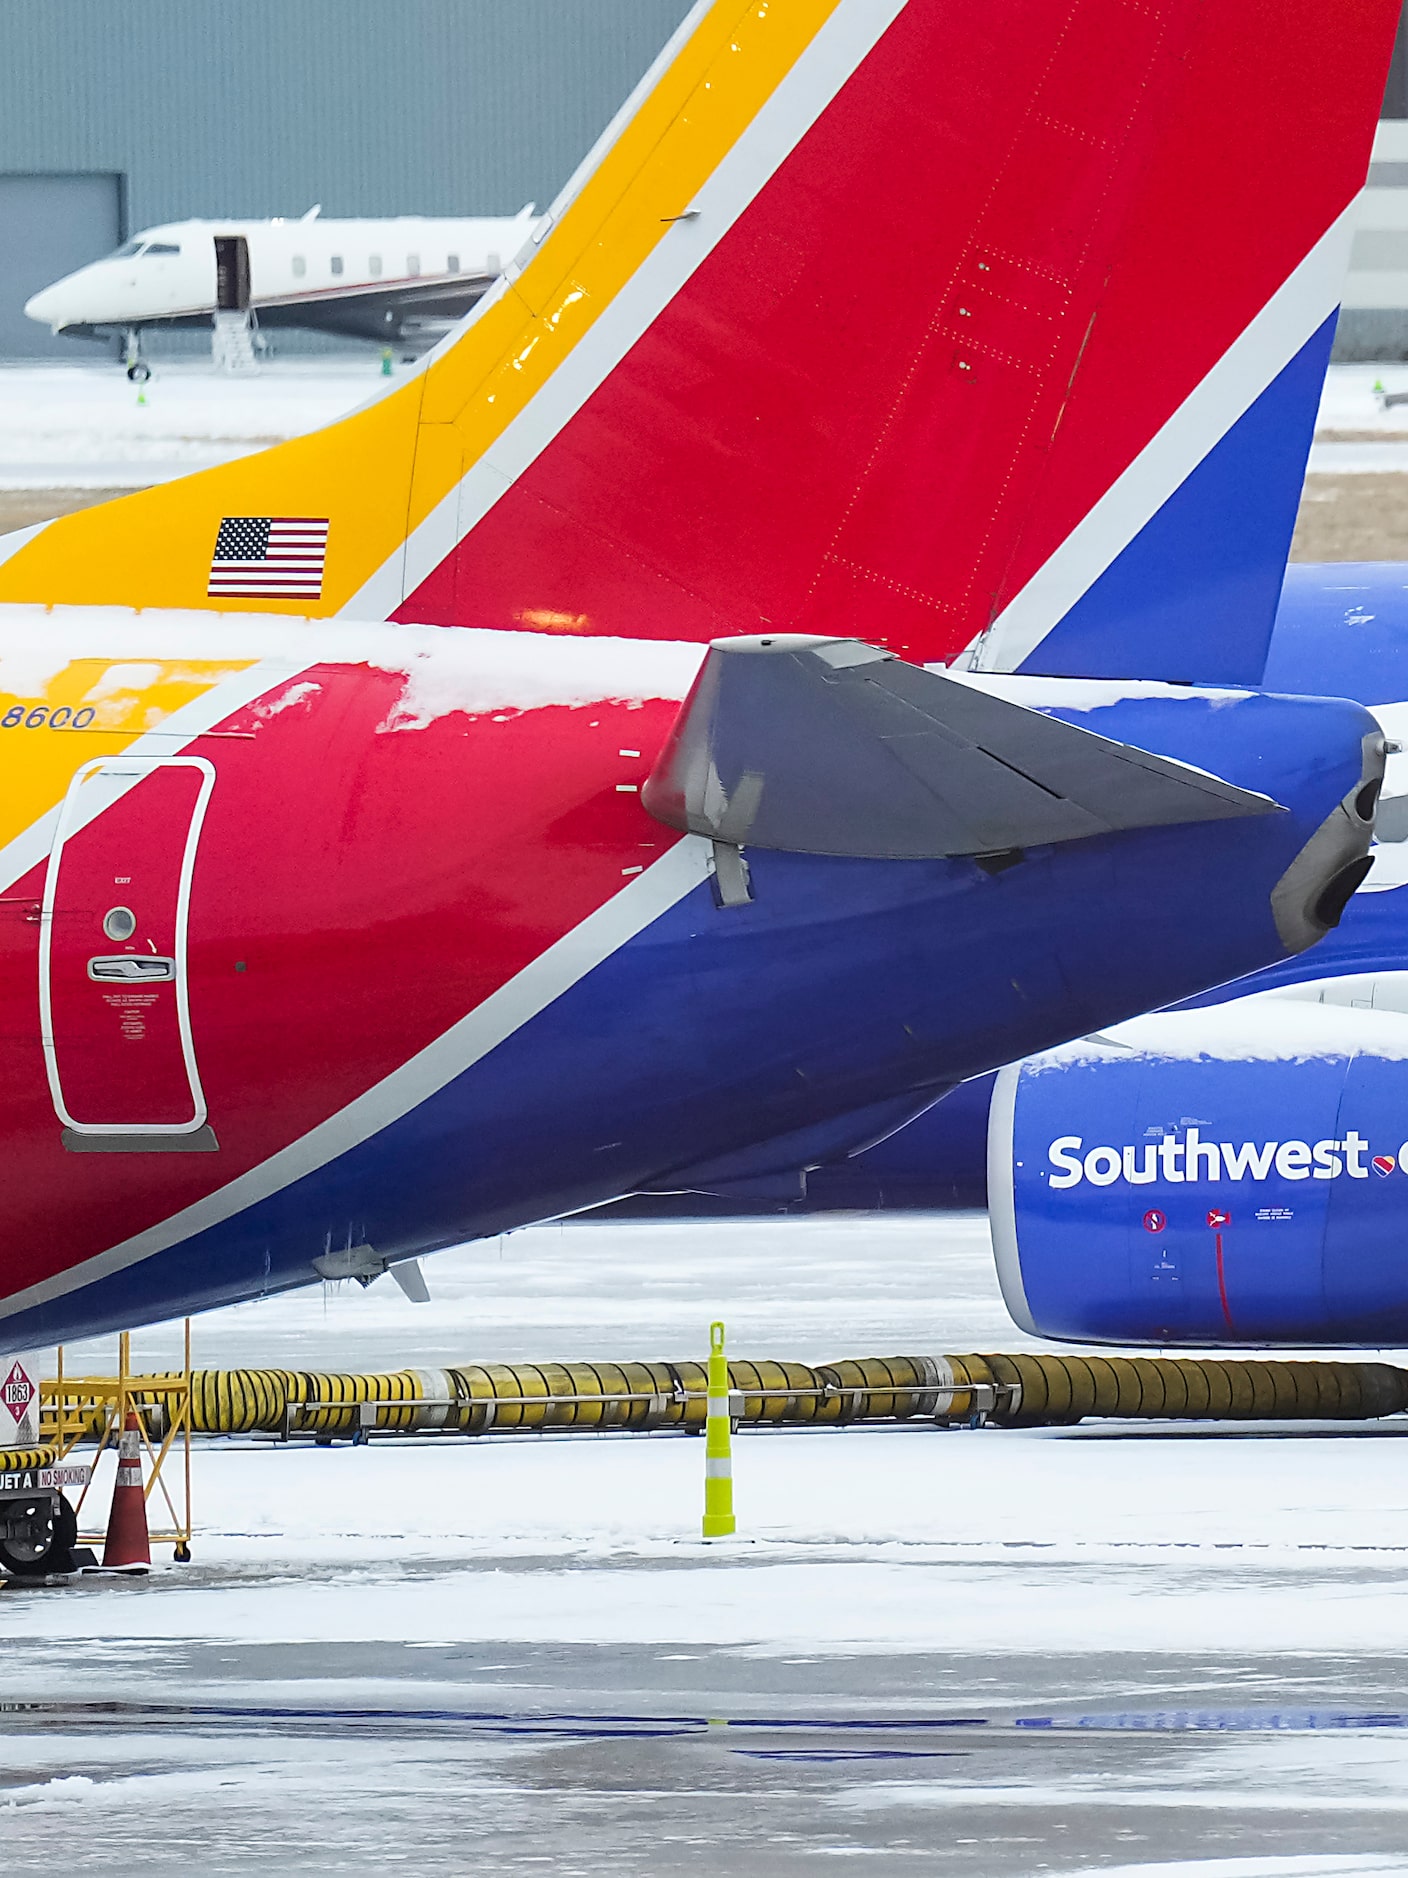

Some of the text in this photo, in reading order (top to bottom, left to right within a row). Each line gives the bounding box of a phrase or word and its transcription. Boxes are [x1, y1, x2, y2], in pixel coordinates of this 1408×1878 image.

[7, 1384, 28, 1402] 1863
[15, 1406, 20, 1416] 3
[23, 1472, 32, 1488] A
[41, 1468, 85, 1486] NO SMOKING
